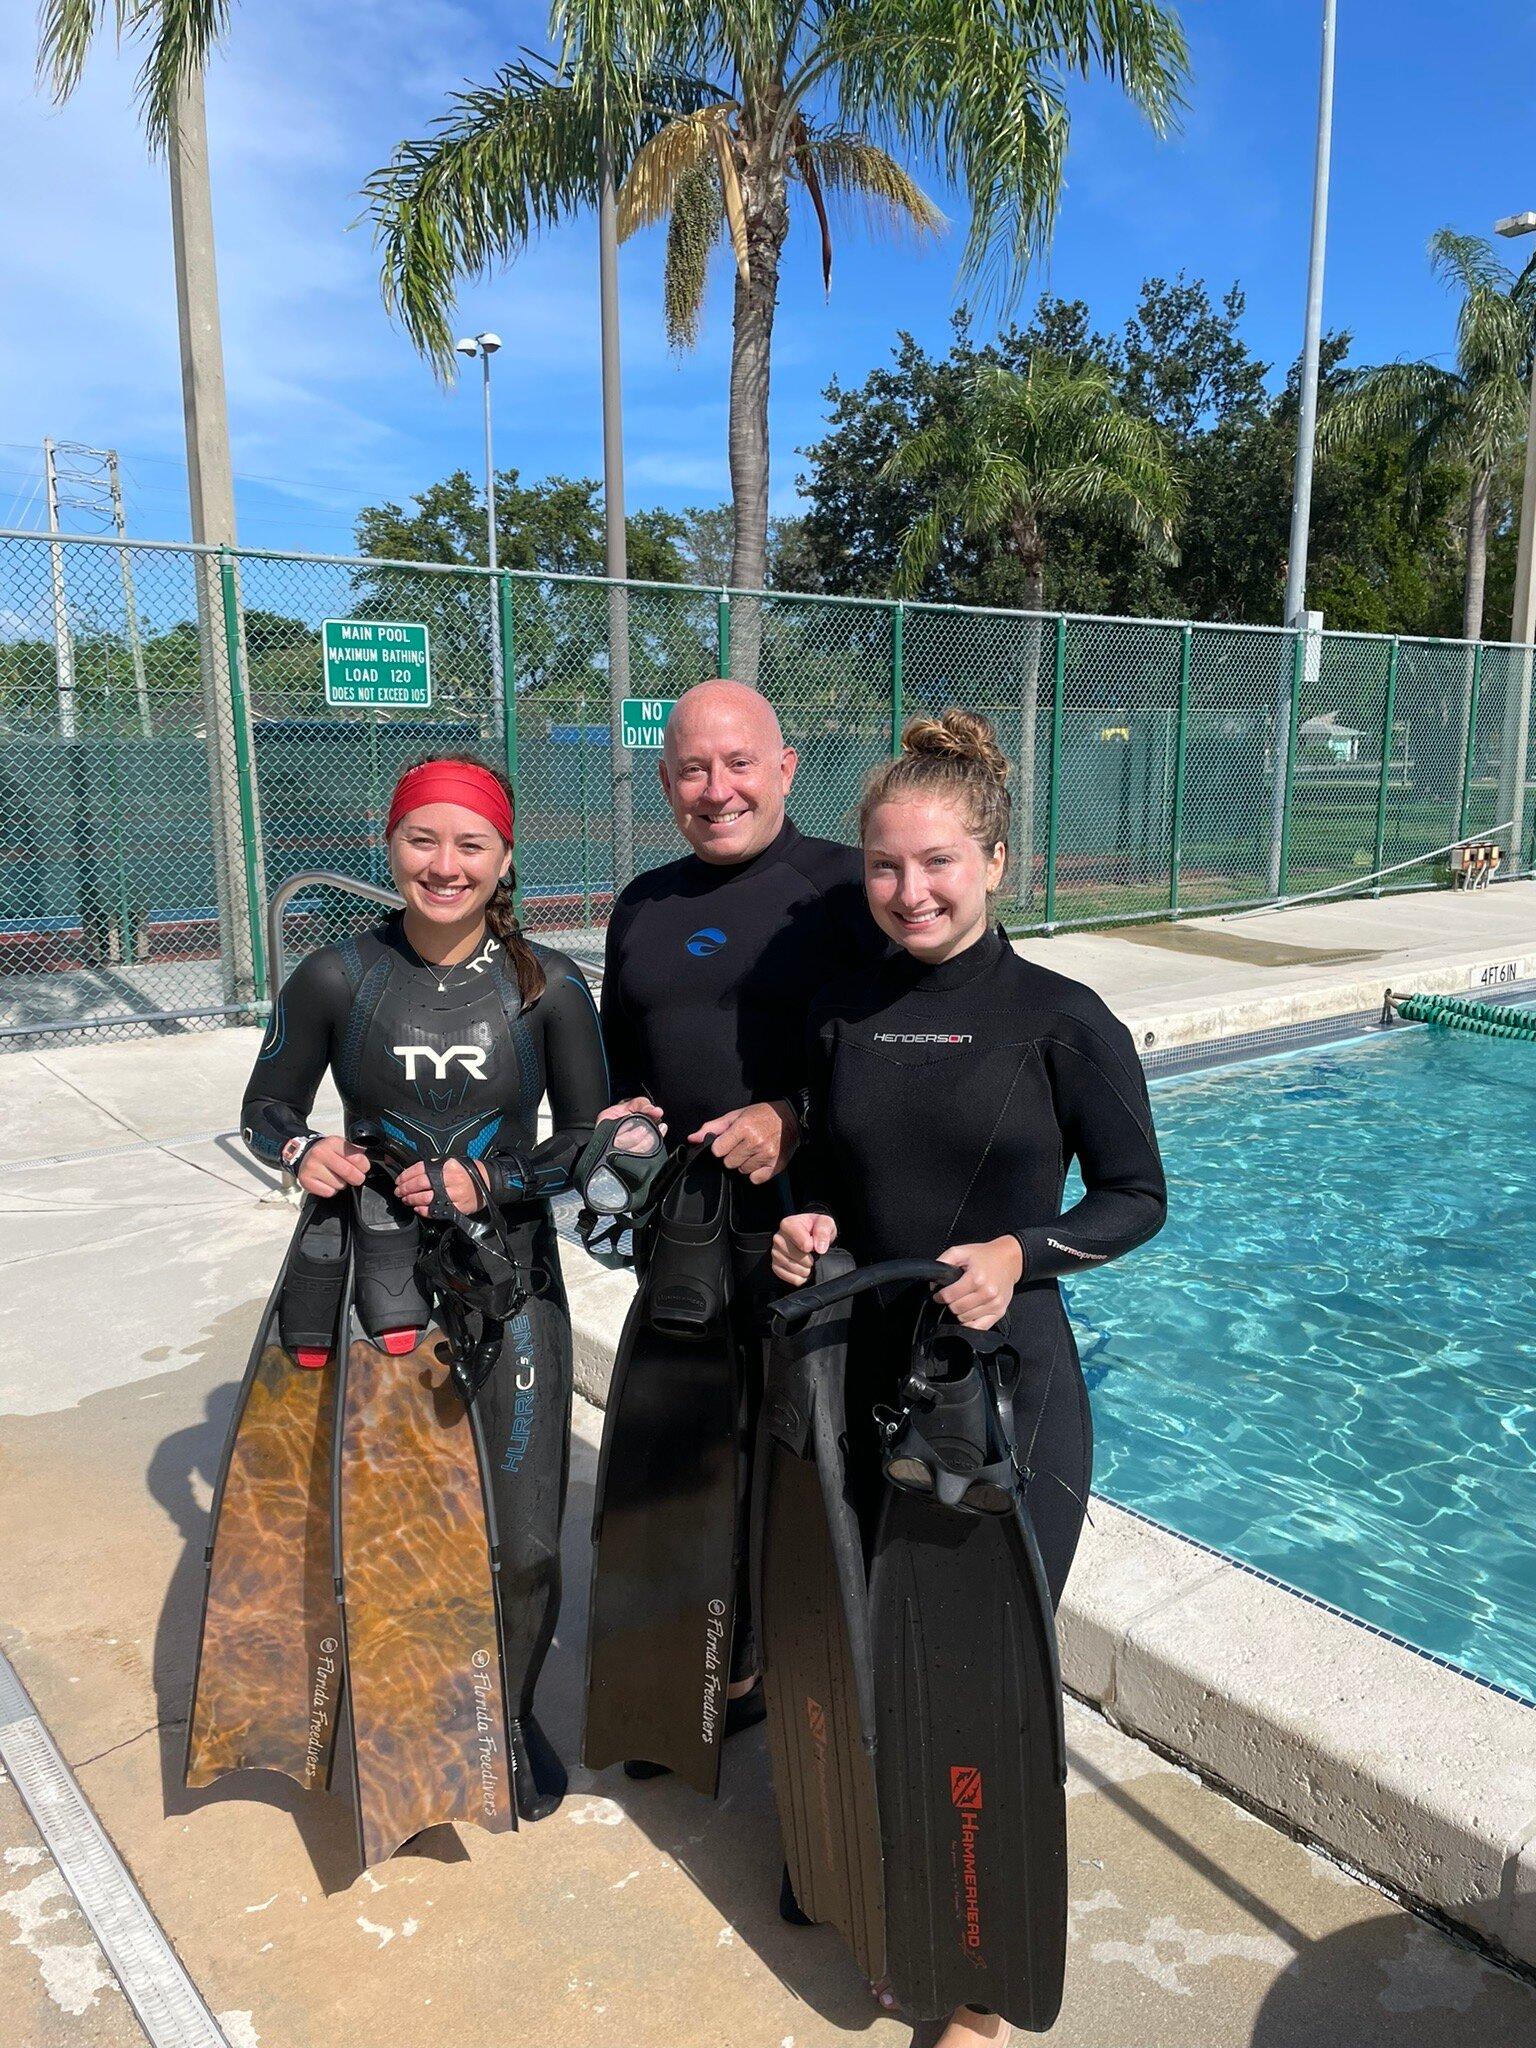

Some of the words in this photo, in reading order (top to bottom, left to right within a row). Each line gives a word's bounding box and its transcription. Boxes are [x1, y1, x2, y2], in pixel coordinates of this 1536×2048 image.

[341, 626, 372, 641] MAIN
[378, 628, 411, 643] POOL
[328, 647, 378, 662] MAXIMUM
[382, 649, 425, 664] BATHING
[345, 668, 378, 682] LOAD
[391, 670, 411, 683] 120
[332, 687, 354, 700] DOES
[358, 688, 374, 701] NOT
[378, 688, 409, 701] EXCEED
[411, 689, 426, 702] 105
[642, 702, 662, 720] NO
[465, 938, 500, 973] TYR
[873, 1033, 973, 1044] HENDERSON
[393, 1046, 488, 1080] TYR
[705, 1618, 724, 1670] Florida
[313, 1656, 335, 1708] Florida
[473, 1672, 493, 1732] Florida
[702, 1673, 721, 1745] Freedivers
[305, 1710, 328, 1777] Freedivers
[478, 1735, 499, 1817] Freedivers
[961, 1812, 980, 1948] HAMMERHEAD
